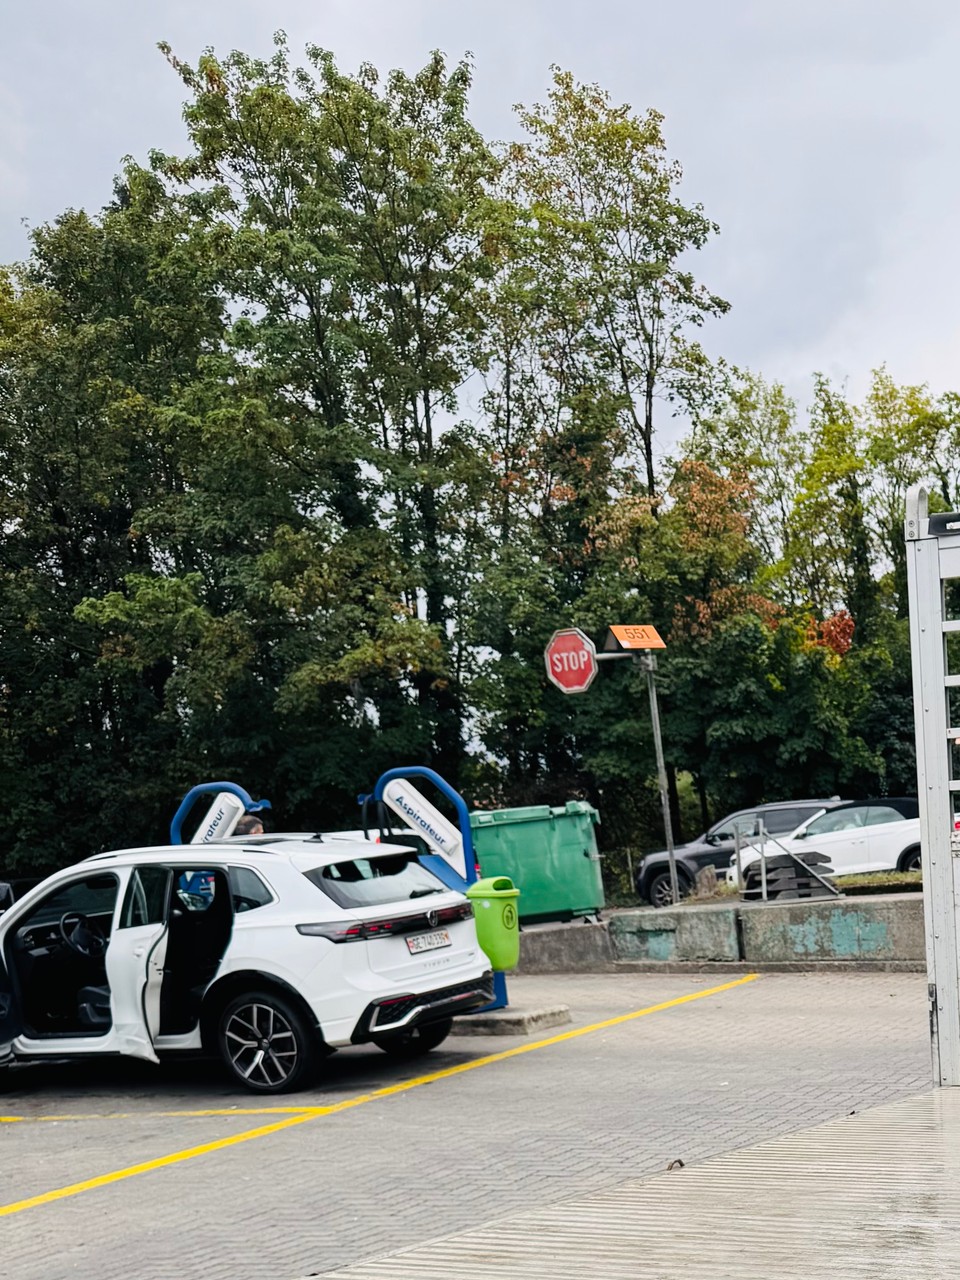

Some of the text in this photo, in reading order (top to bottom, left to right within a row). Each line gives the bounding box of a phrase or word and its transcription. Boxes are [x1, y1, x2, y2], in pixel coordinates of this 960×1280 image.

[624, 628, 650, 640] 551
[552, 650, 589, 673] STOP
[201, 807, 225, 843] irateur
[395, 795, 446, 845] Aspirateur
